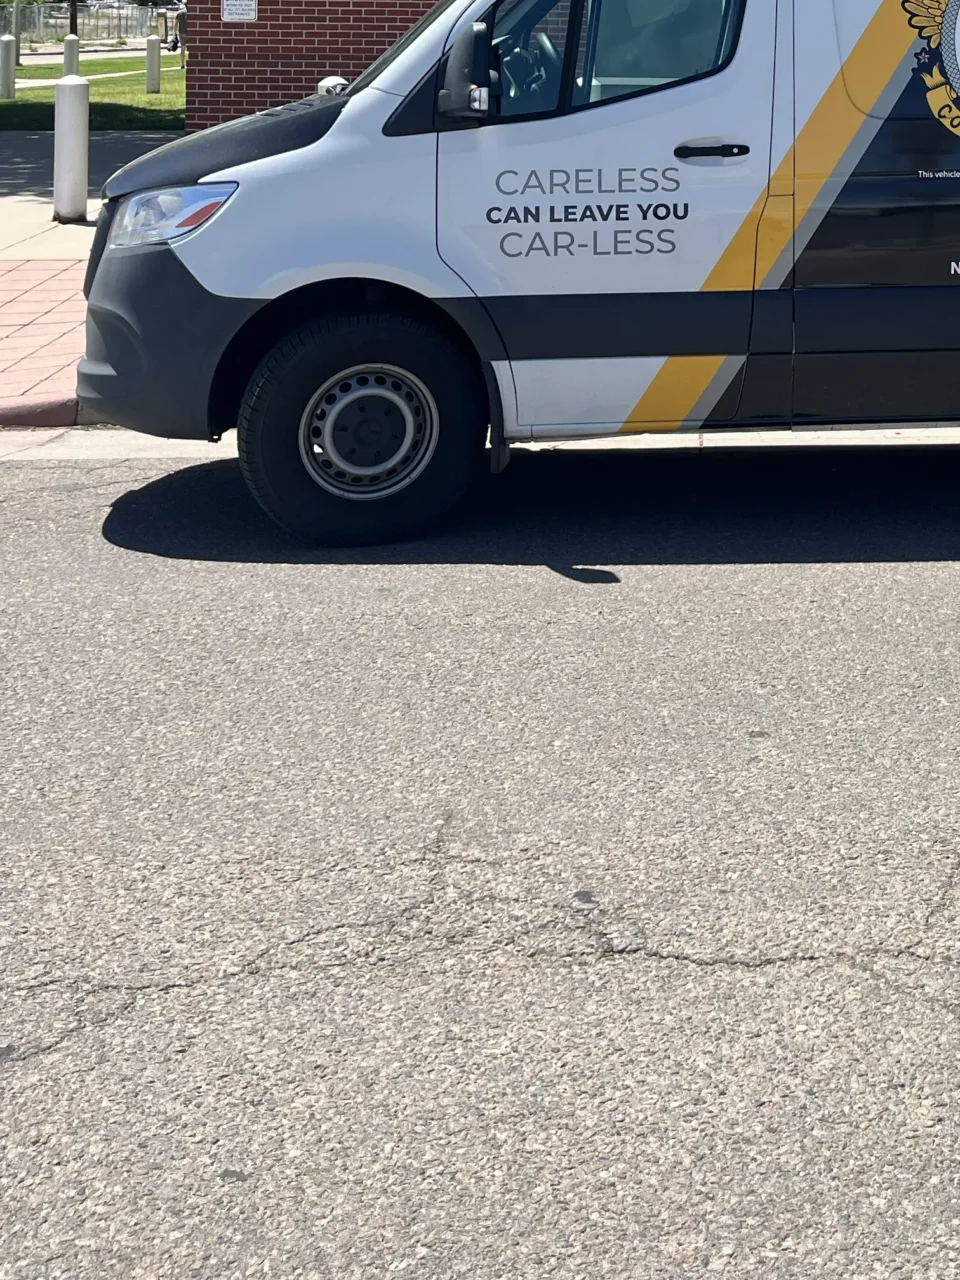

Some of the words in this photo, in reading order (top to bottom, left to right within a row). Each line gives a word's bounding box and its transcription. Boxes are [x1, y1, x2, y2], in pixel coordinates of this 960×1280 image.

[495, 167, 681, 196] CARELESS
[918, 170, 933, 178] This
[935, 170, 960, 178] vehicle
[486, 206, 540, 223] CAN
[549, 204, 629, 222] LEAVE
[636, 203, 689, 220] YOU
[499, 229, 676, 257] CAR-LESS
